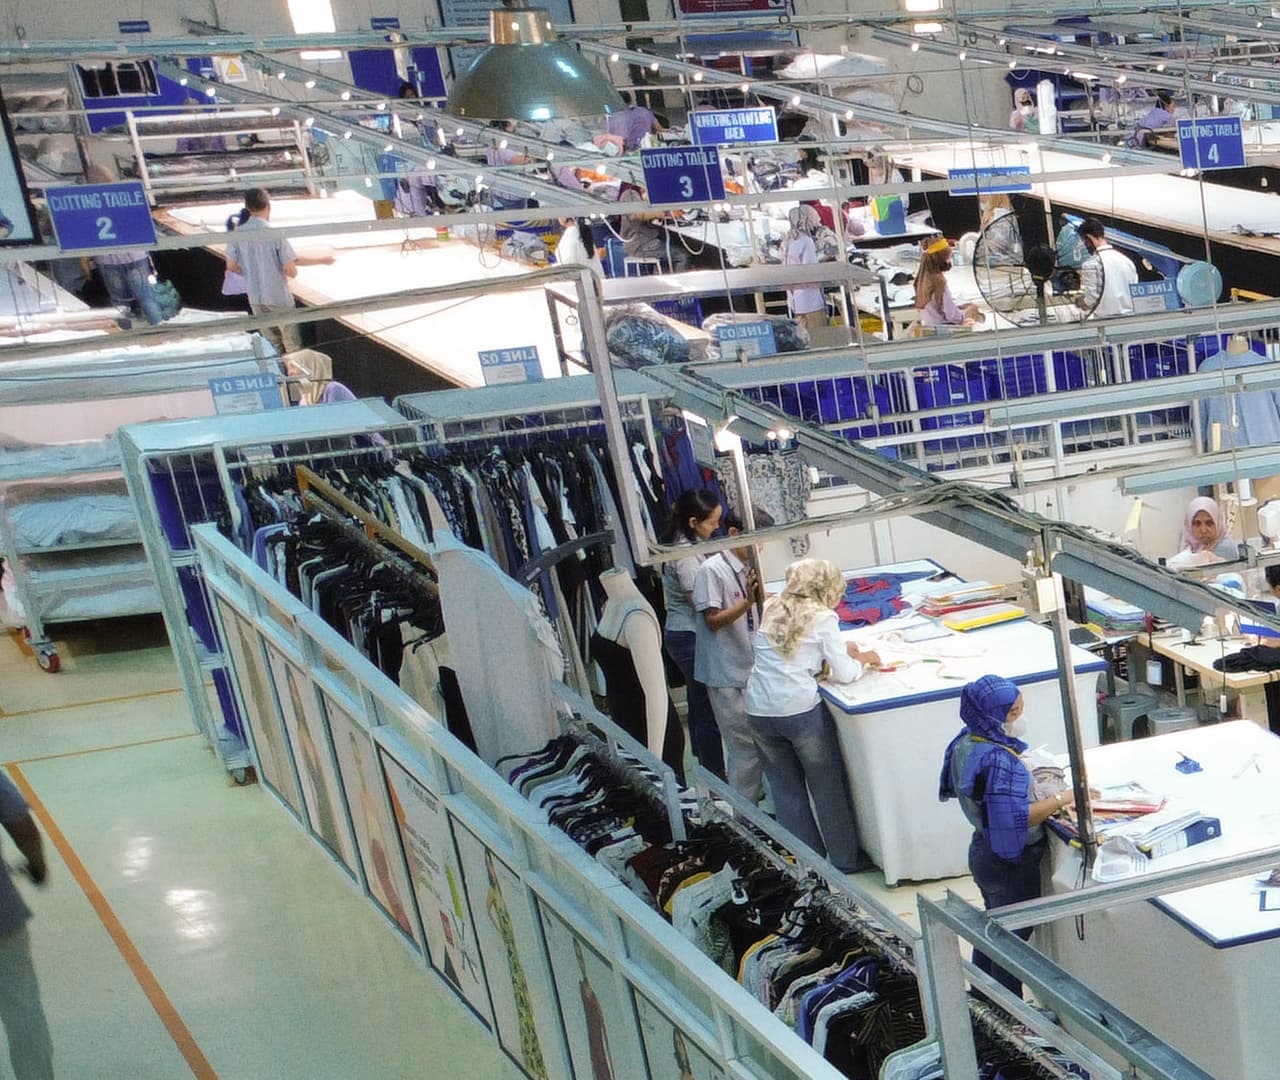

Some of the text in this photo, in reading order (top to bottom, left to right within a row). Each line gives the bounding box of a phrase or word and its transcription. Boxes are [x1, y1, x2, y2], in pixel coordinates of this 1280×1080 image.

[1214, 123, 1241, 137] TABLE
[643, 152, 683, 169] CUTTING
[1207, 143, 1219, 164] 4
[679, 175, 694, 198] 3
[51, 190, 145, 212] CUTTING TABLE
[96, 217, 116, 240] 2
